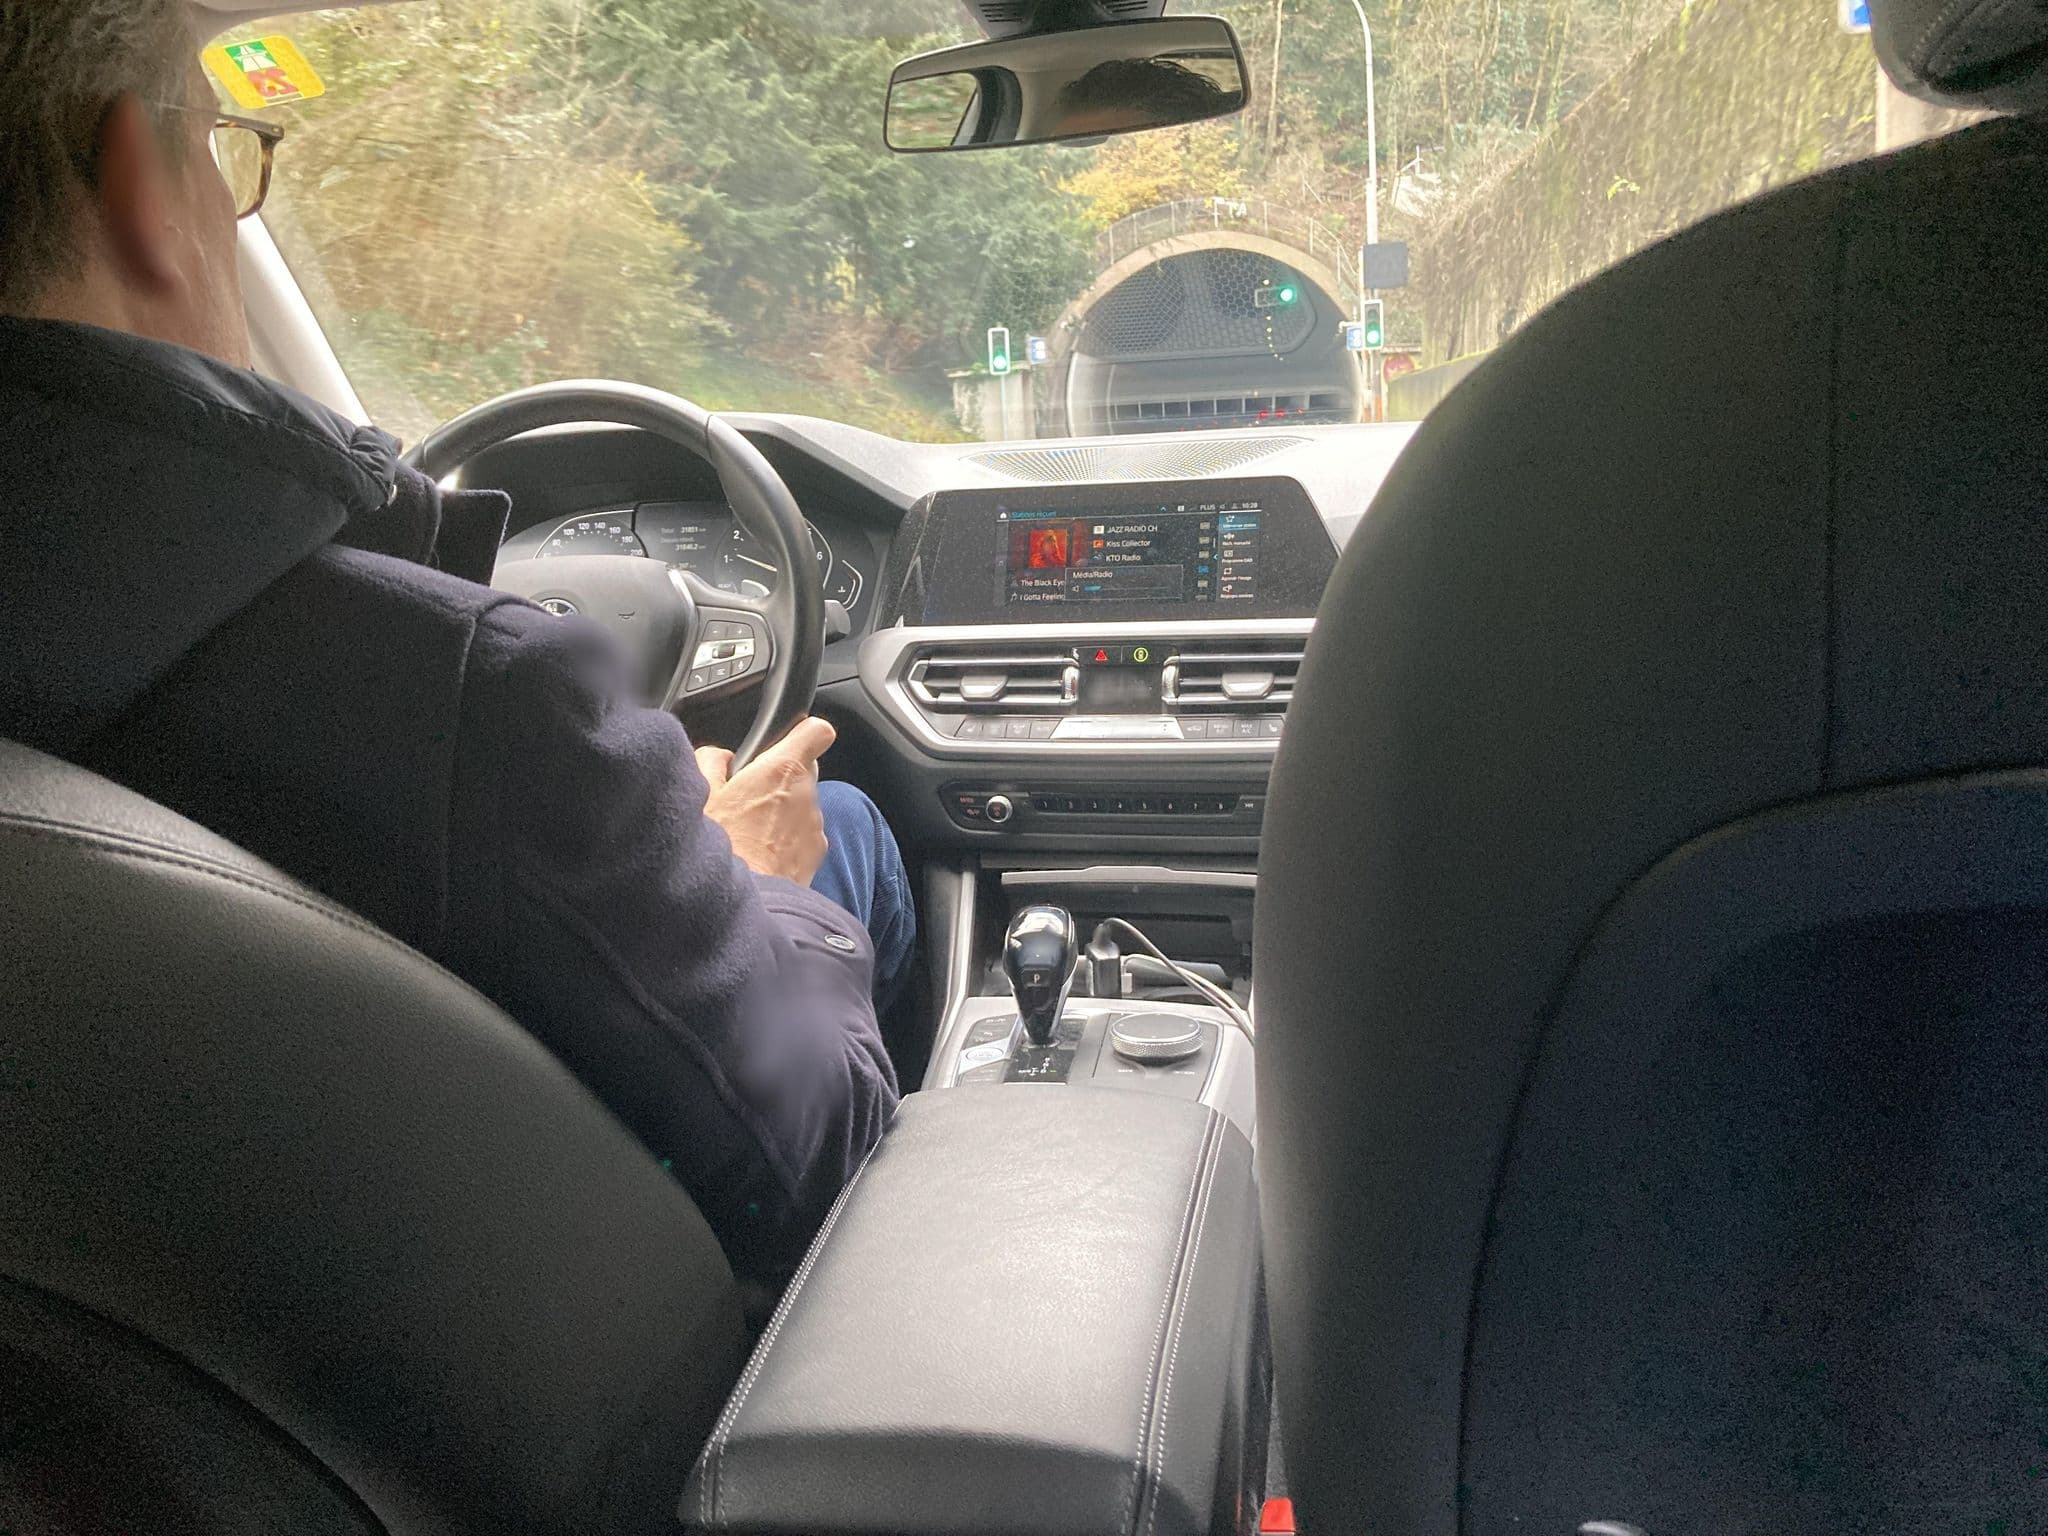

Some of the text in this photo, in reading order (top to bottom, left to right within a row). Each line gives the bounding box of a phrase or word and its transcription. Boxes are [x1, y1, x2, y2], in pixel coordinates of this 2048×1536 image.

[578, 522, 590, 530] 120
[1107, 524, 1158, 534] JAZZ RADIO CH
[733, 530, 740, 539] 2
[1106, 539, 1151, 548] Kiss Collector
[816, 551, 823, 560] 6
[1105, 554, 1120, 562] KTO
[1042, 593, 1066, 602] Feeling
[1033, 973, 1041, 984] P
